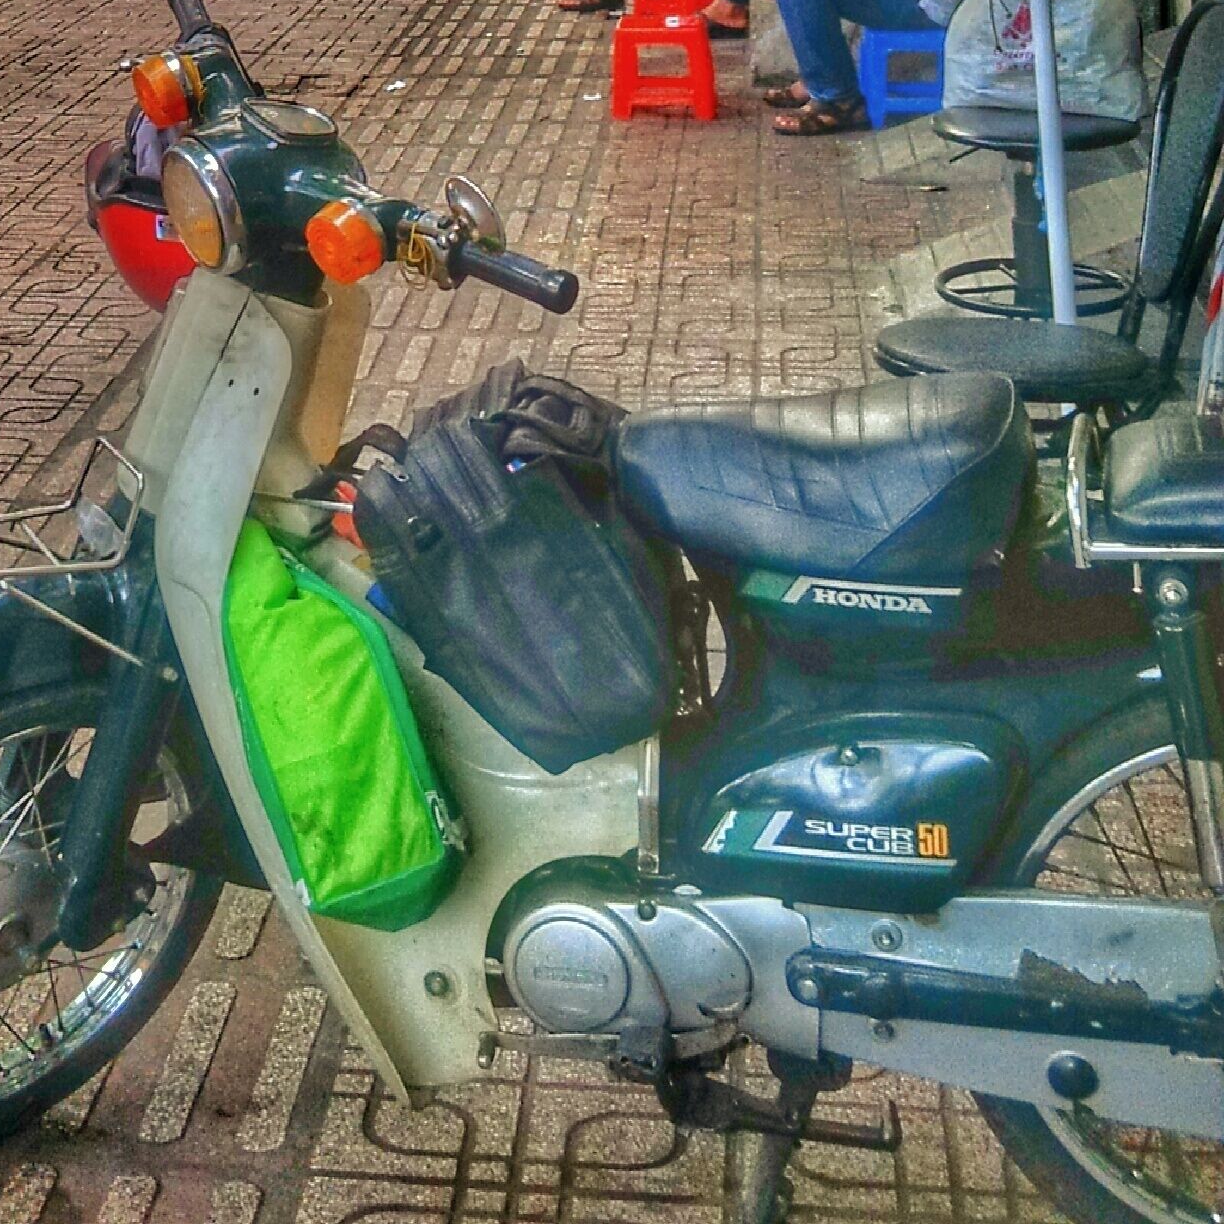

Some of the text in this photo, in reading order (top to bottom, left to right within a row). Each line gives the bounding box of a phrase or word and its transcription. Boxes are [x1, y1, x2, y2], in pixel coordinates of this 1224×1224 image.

[813, 587, 933, 614] HONDA
[805, 819, 914, 840] SUPER
[846, 822, 948, 857] CUB 50
